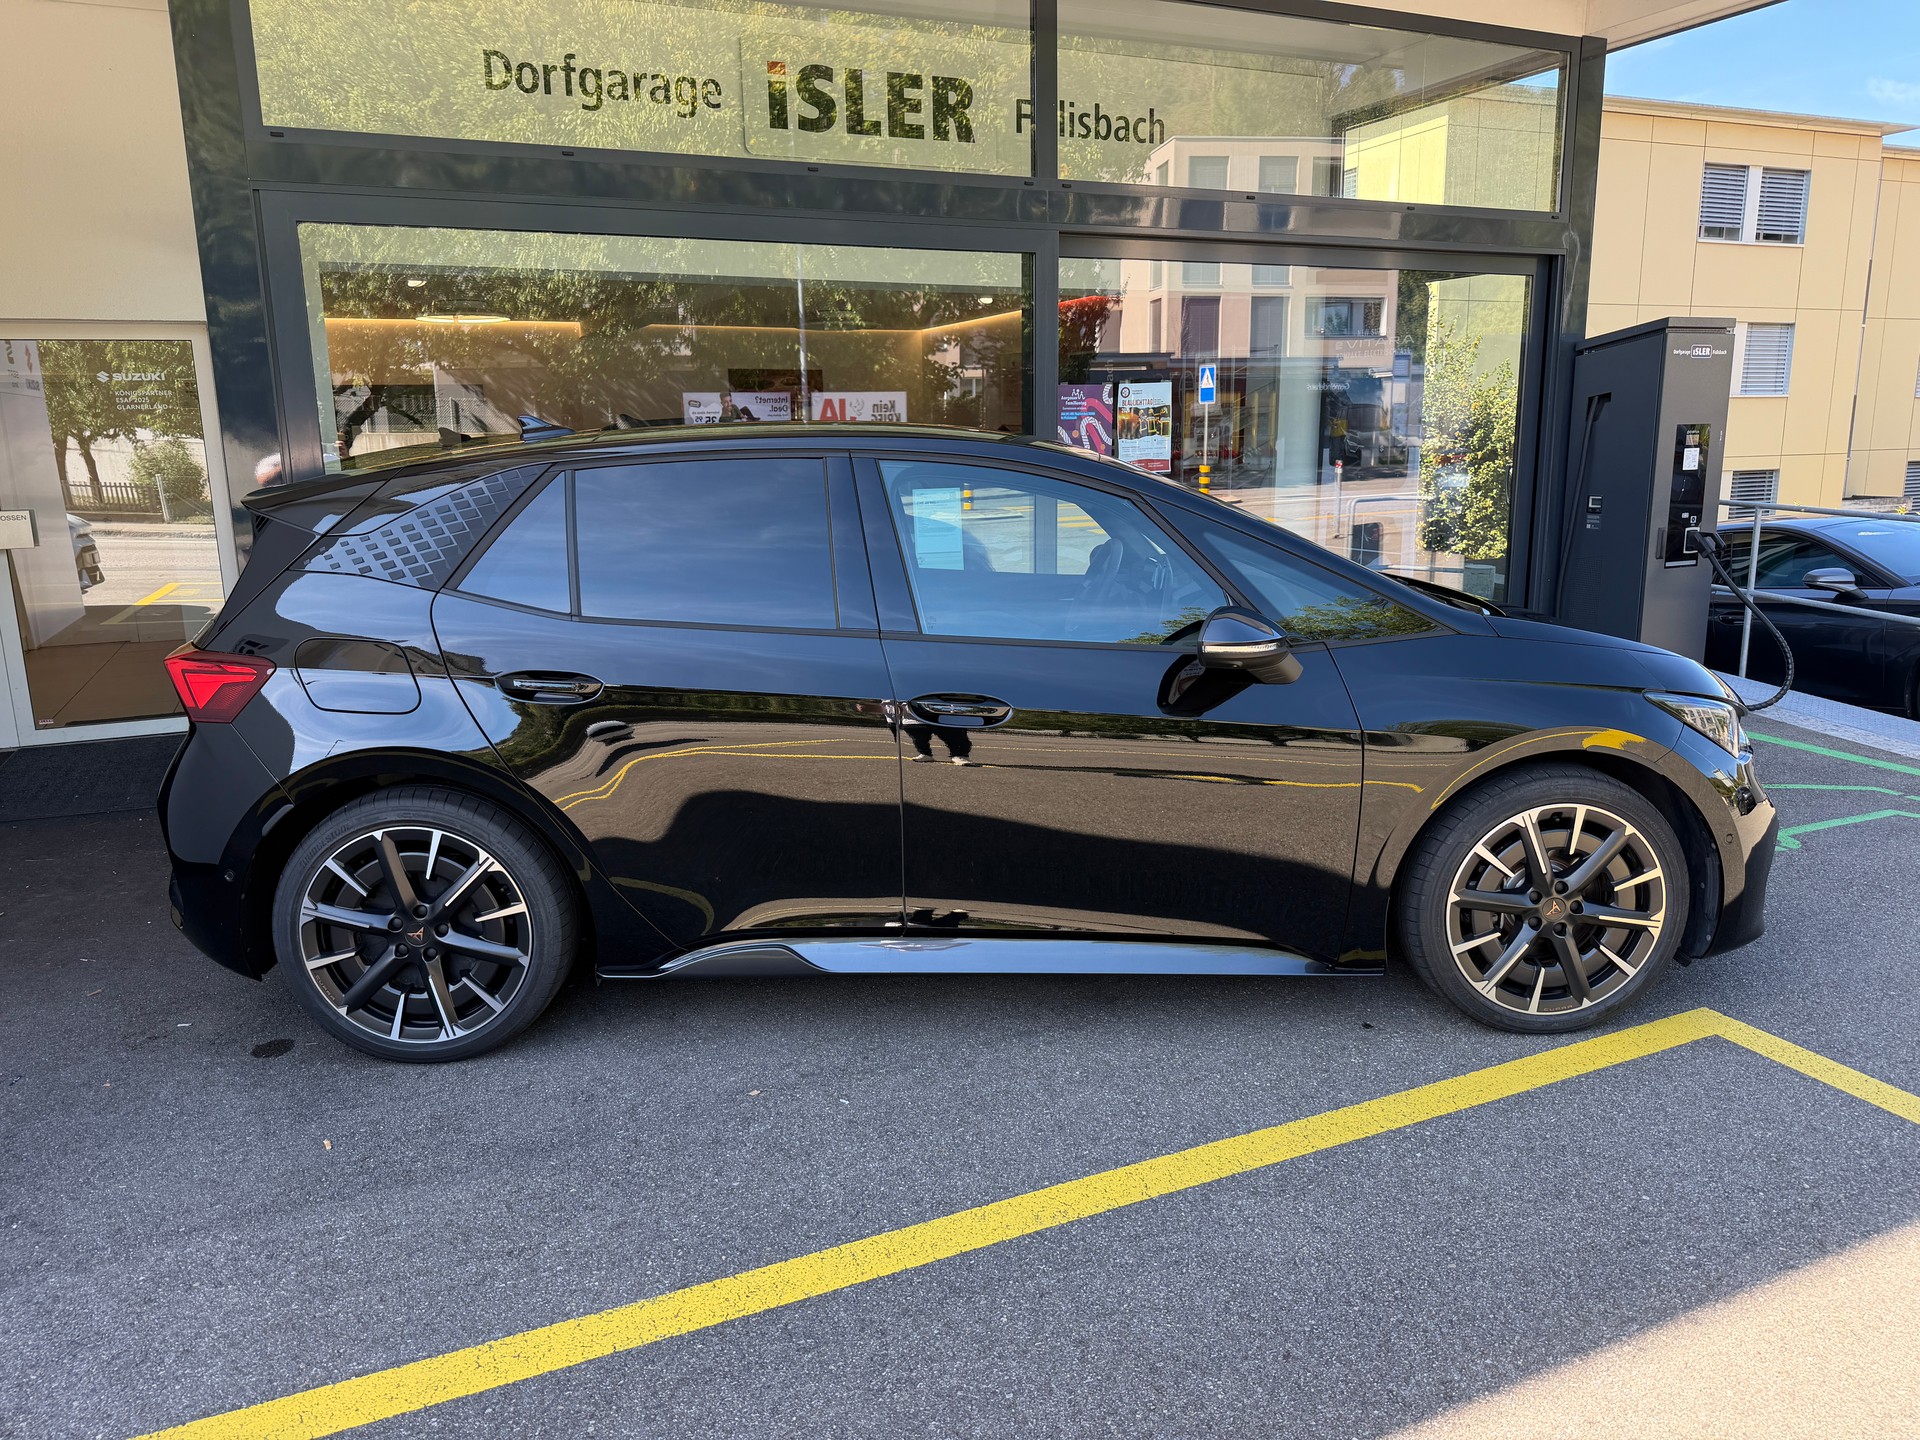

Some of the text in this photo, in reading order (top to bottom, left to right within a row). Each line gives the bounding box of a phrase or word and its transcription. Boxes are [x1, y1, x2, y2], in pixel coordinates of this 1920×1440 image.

[482, 49, 722, 119] Dorfgarage
[1016, 99, 1165, 145] Flisbach
[112, 372, 166, 381] SUZUKI
